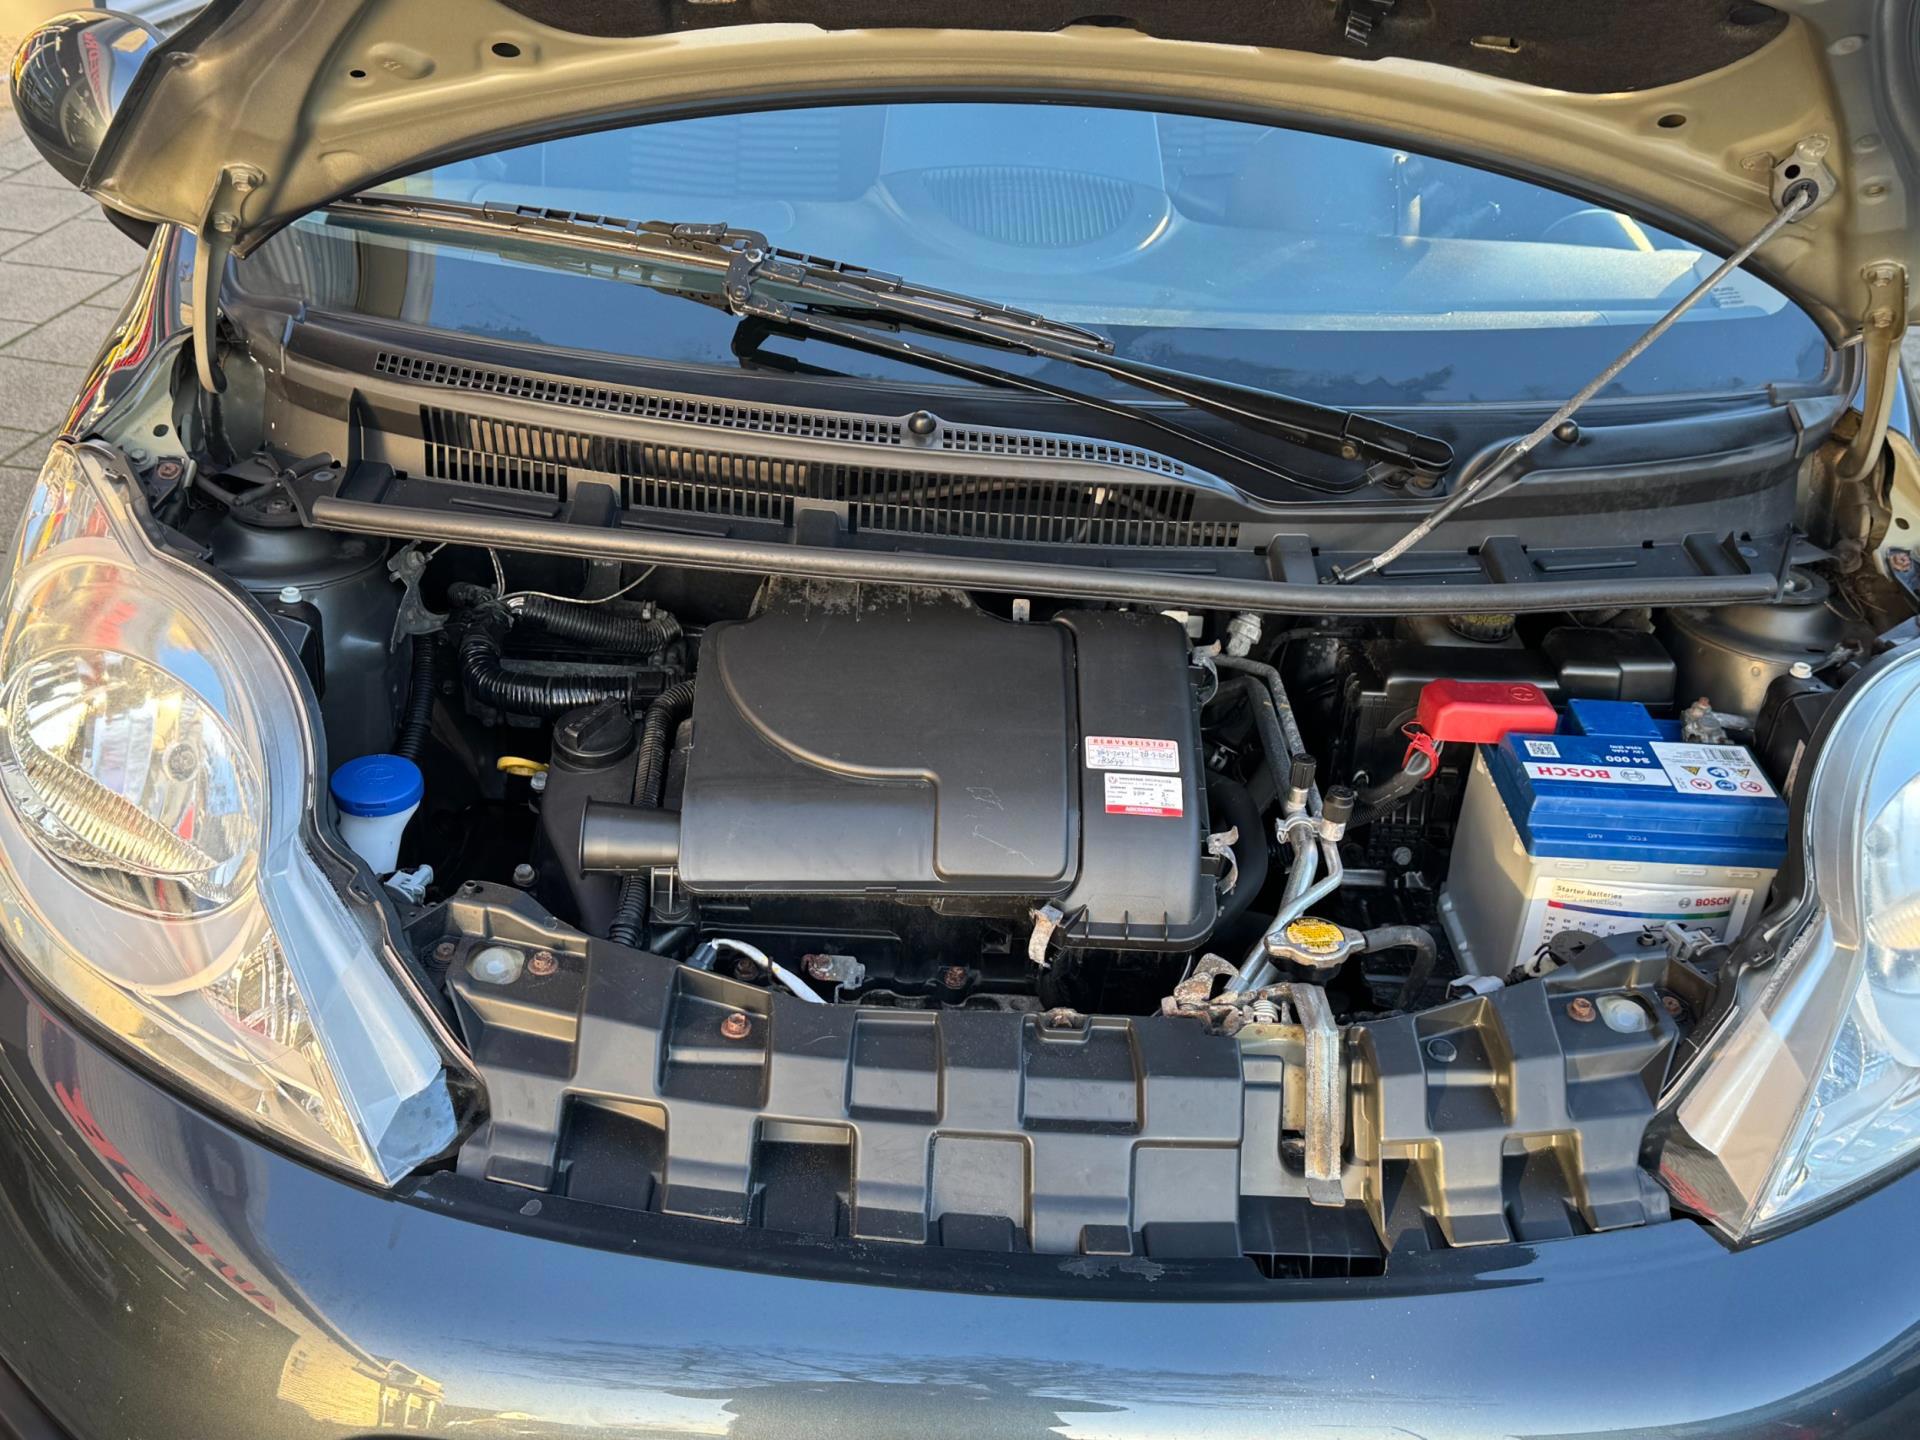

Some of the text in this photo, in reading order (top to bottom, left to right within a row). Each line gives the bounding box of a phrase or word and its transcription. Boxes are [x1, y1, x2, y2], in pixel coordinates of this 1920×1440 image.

[1605, 755, 1630, 763] 000
[1537, 766, 1611, 779] BOSCH
[1557, 885, 1622, 900] Starter batteries
[1695, 896, 1731, 907] BOSCH
